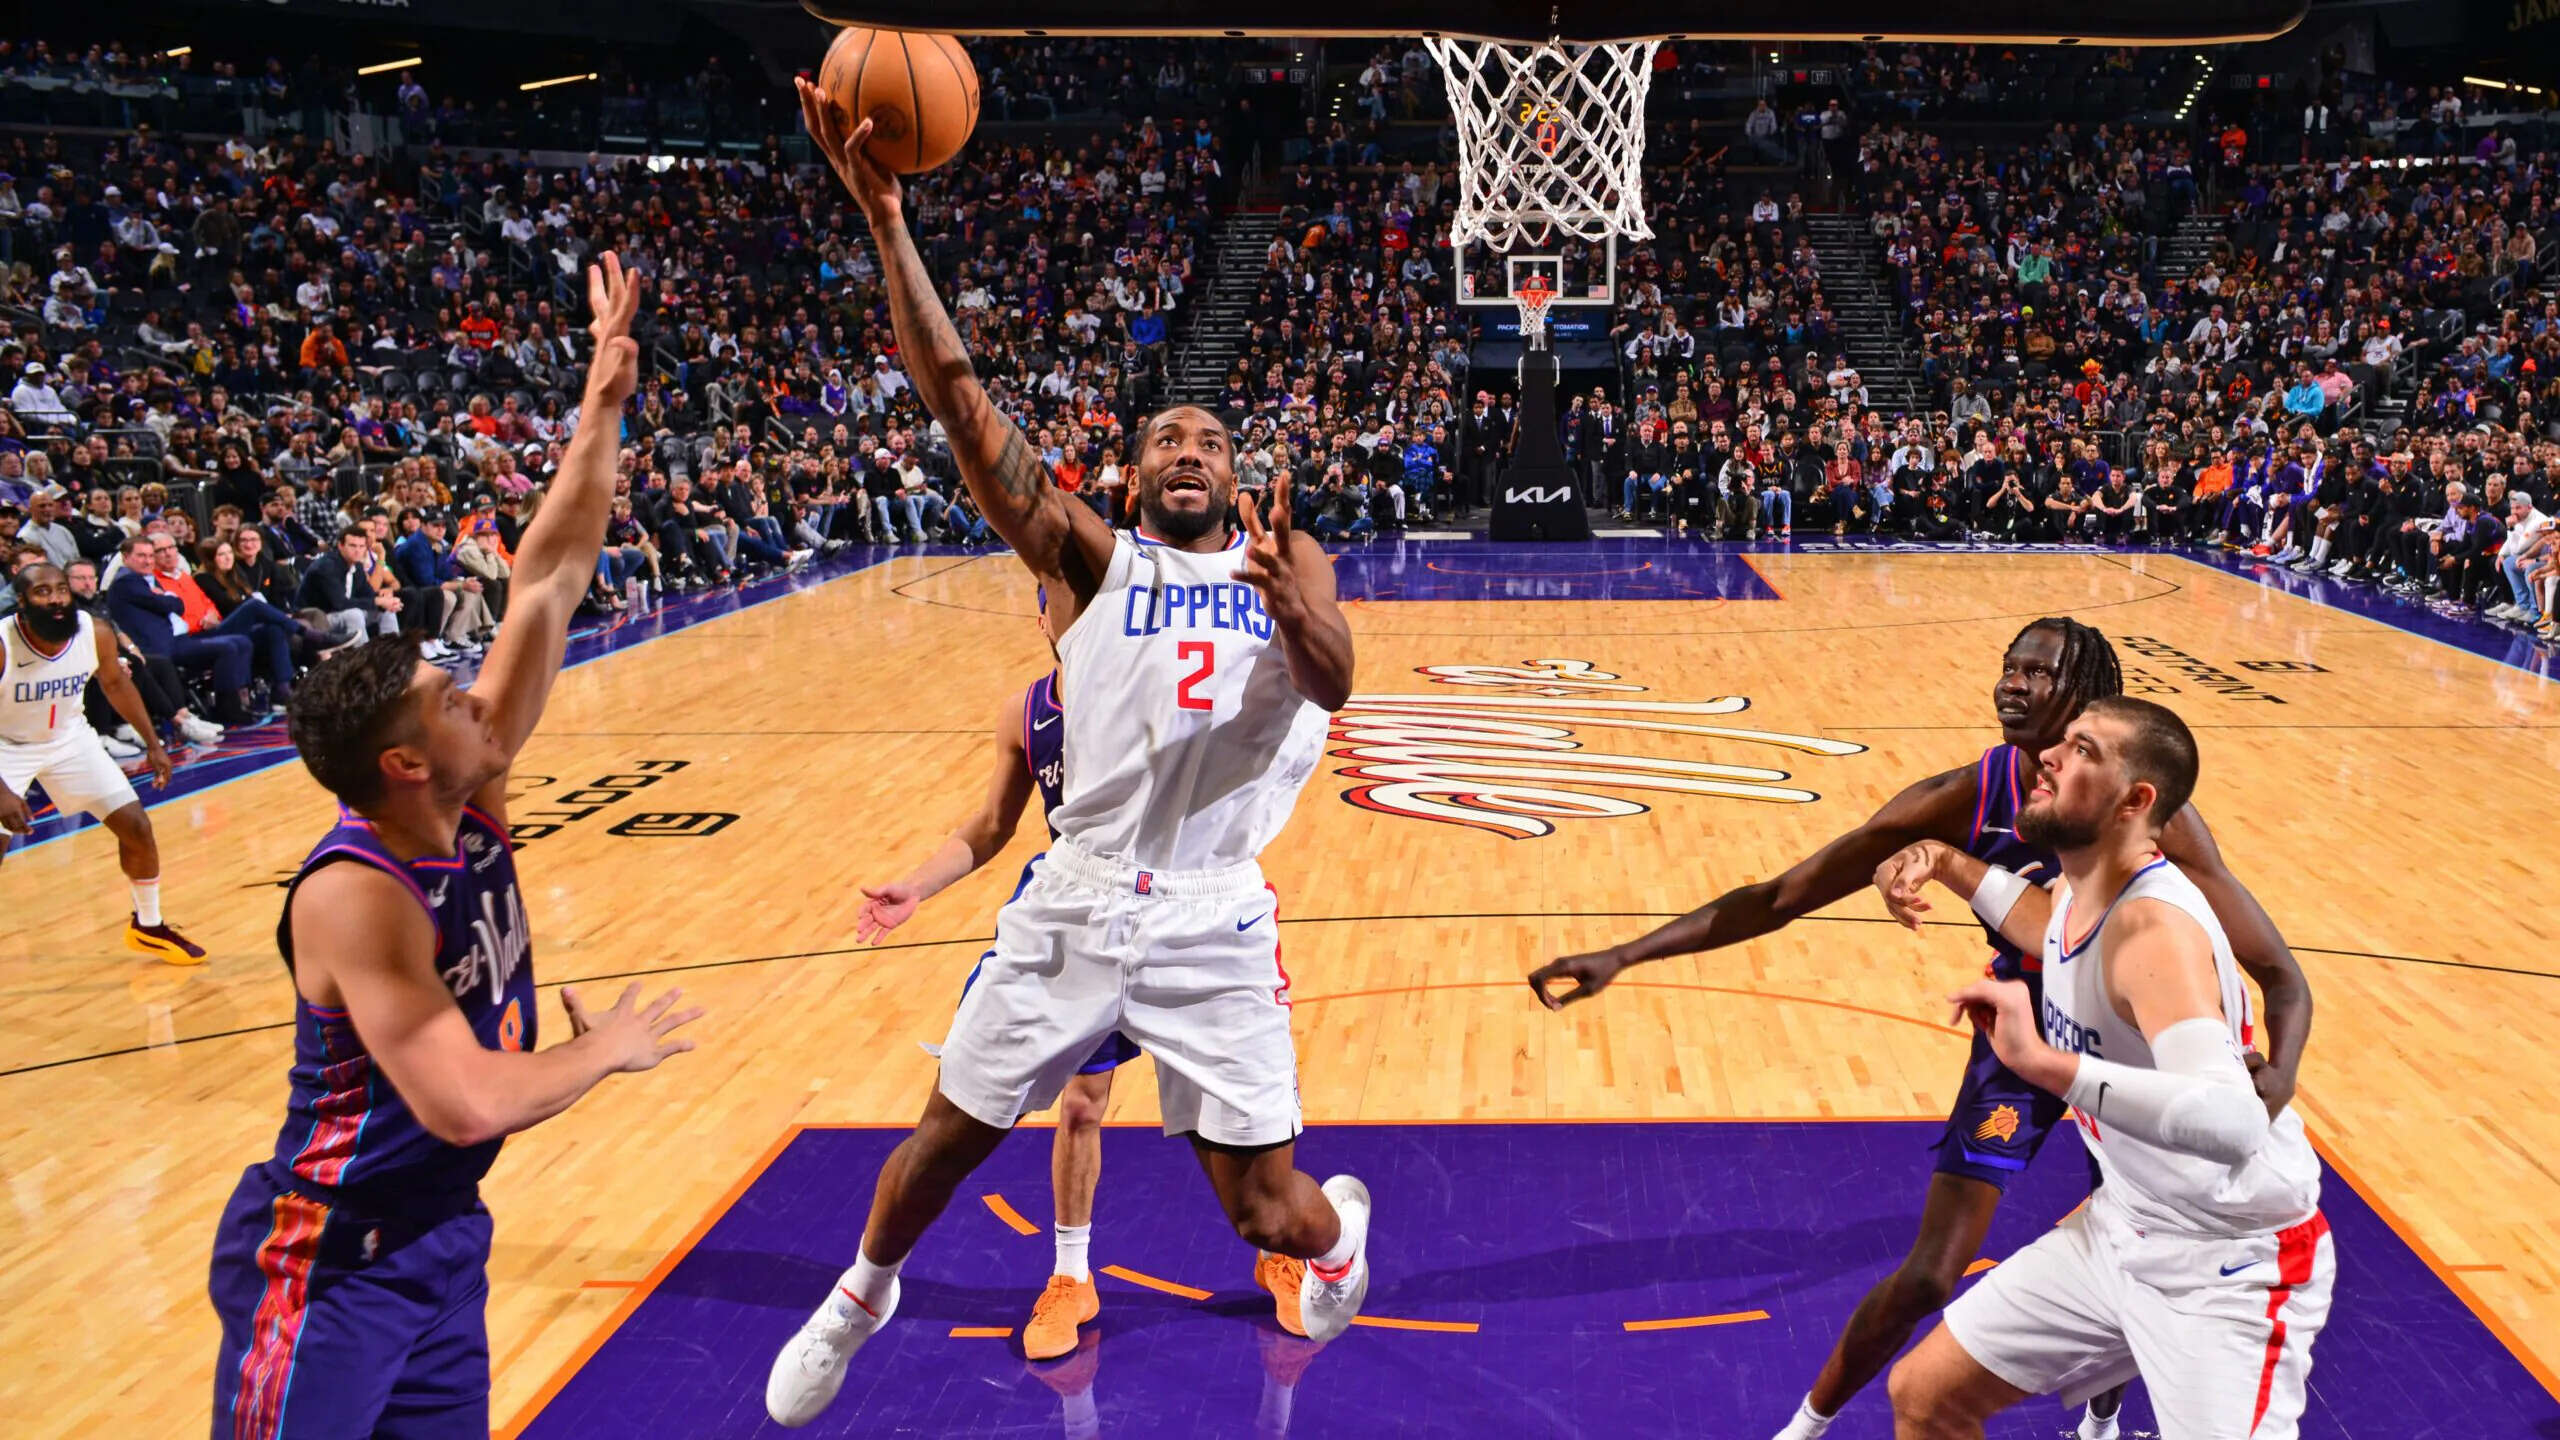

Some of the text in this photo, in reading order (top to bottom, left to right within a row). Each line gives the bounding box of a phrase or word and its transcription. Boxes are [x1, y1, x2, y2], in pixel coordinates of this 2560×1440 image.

[1505, 486, 1572, 503] KIA
[1177, 640, 1215, 711] 2
[48, 703, 57, 729] 1
[2044, 993, 2105, 1061] PPERS
